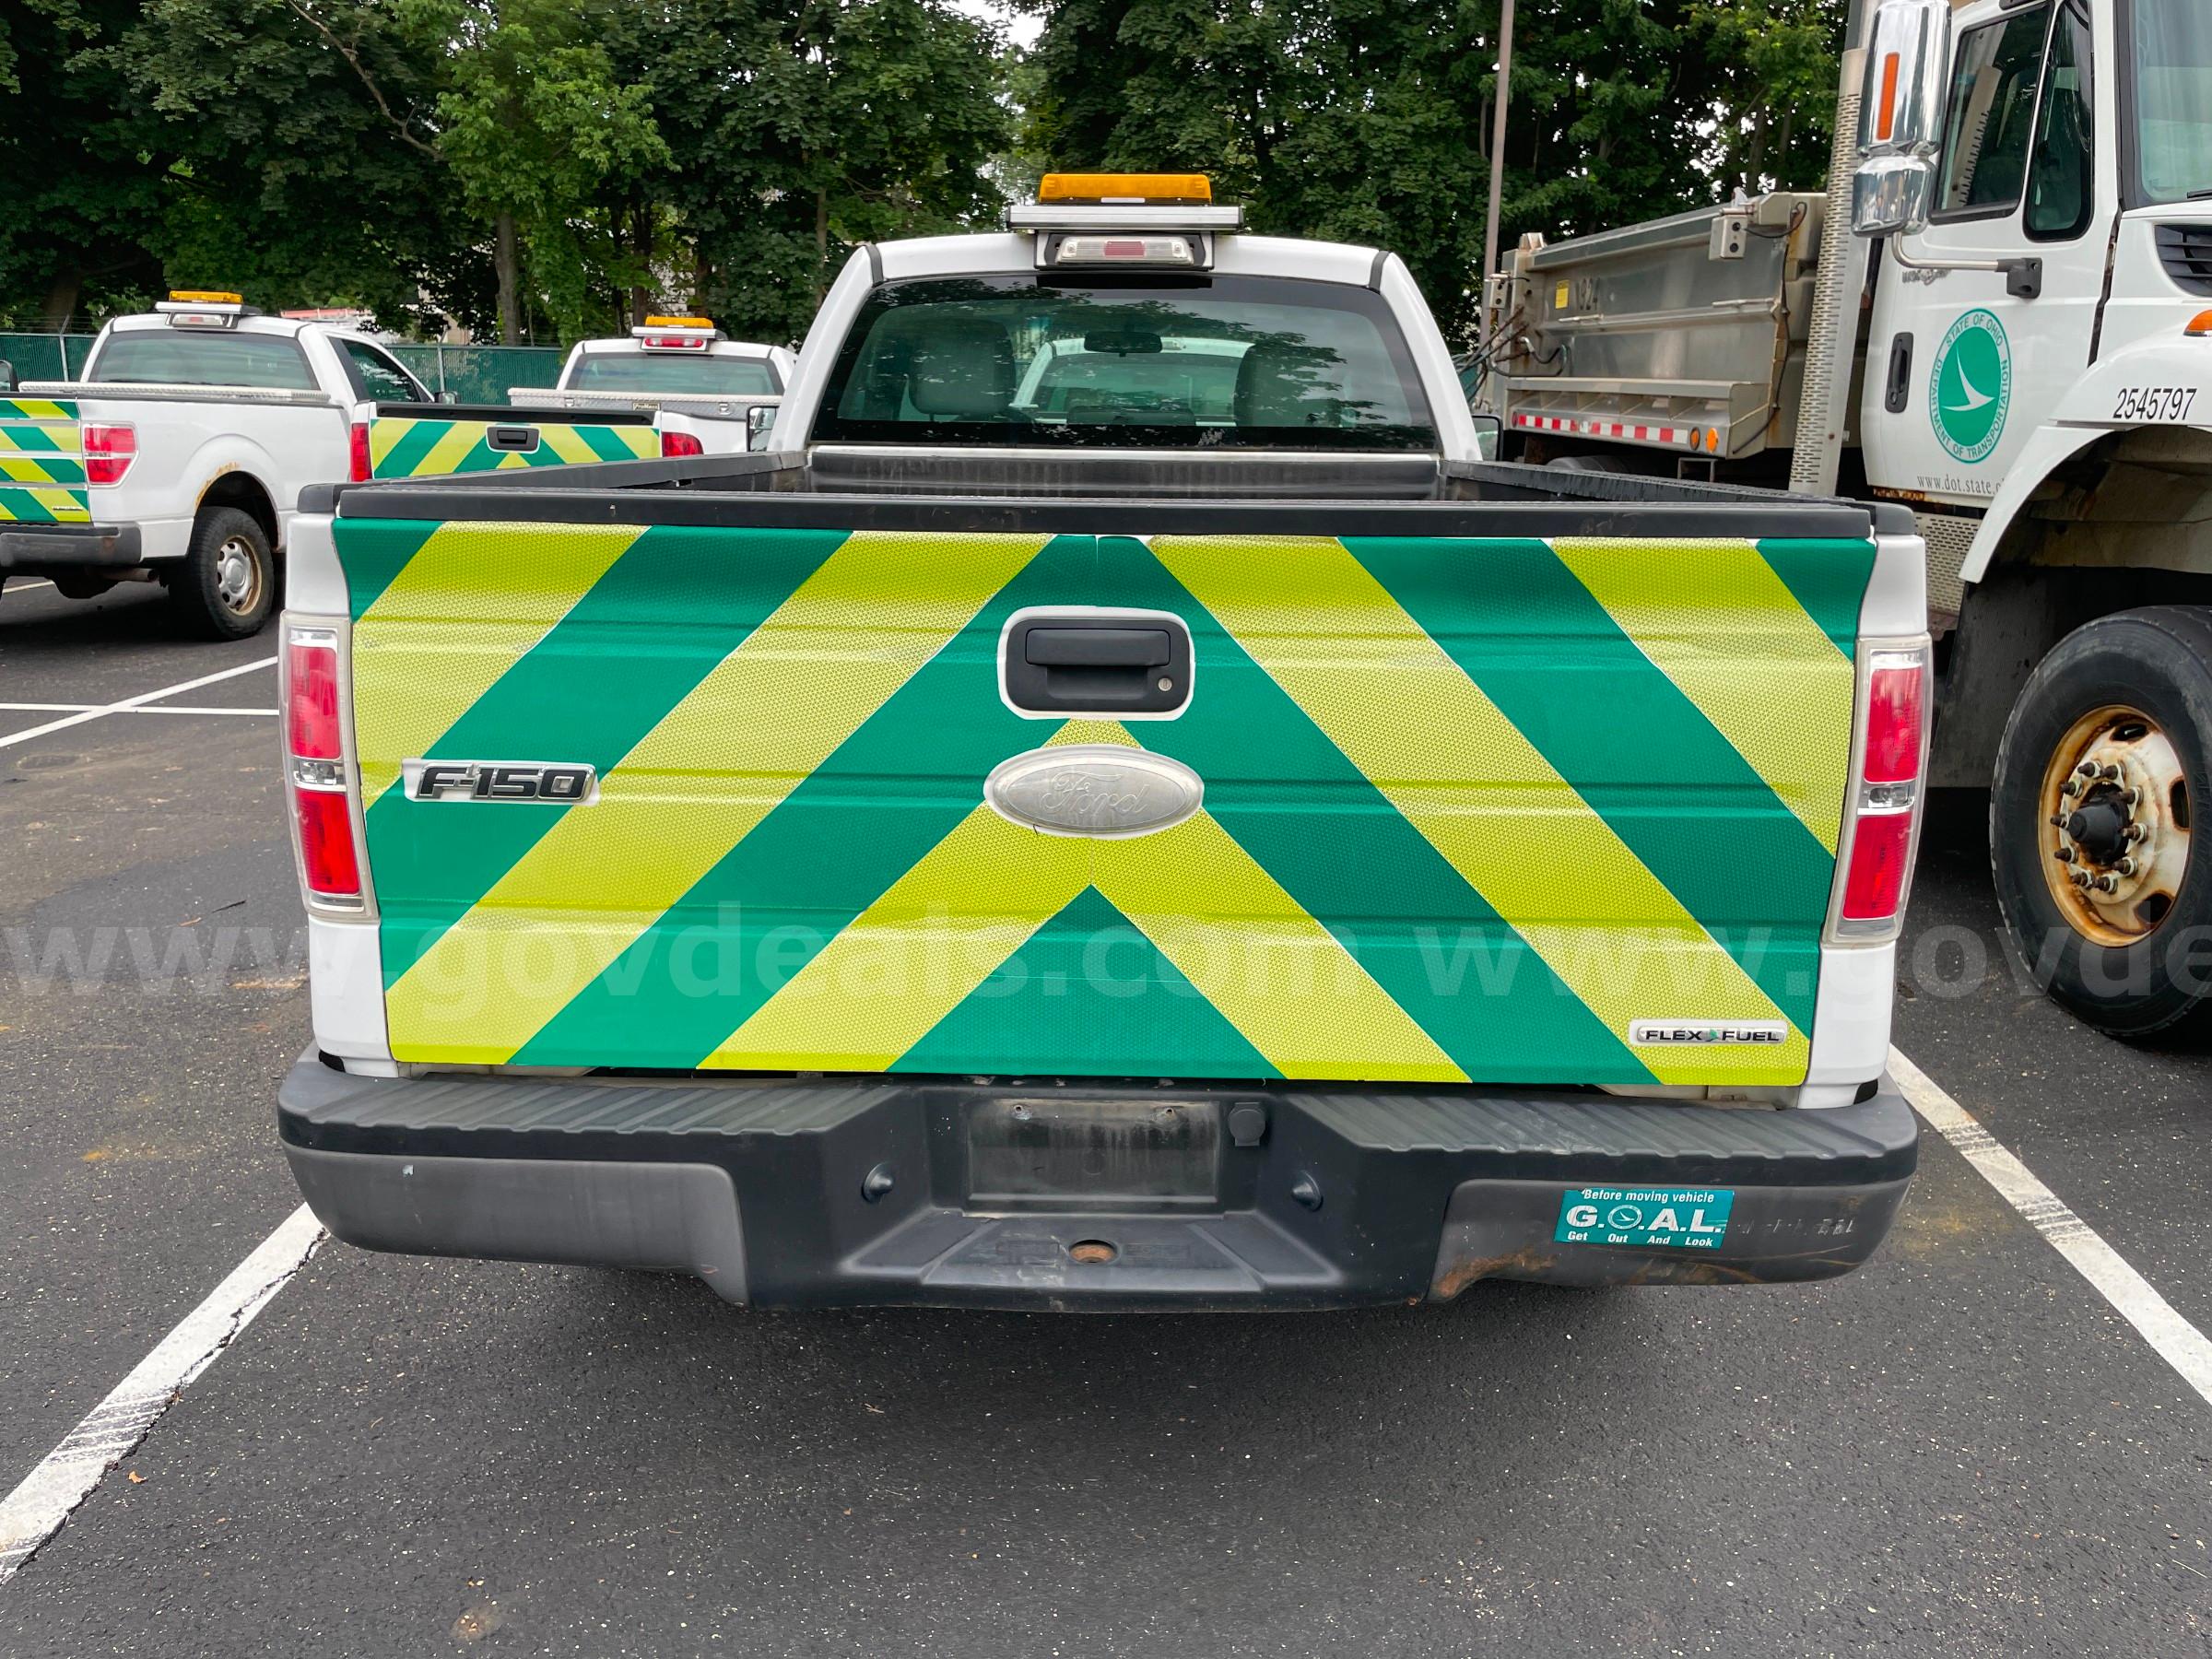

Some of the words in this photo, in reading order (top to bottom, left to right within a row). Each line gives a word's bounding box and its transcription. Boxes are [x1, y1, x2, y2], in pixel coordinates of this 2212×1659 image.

[1946, 317, 1970, 347] STATE
[1972, 314, 1985, 325] OF
[1986, 318, 2004, 347] OHIO
[1931, 359, 1952, 447] DEPARTMENT
[1953, 445, 1964, 456] OF
[1968, 359, 2008, 458] TRANSPORTATION
[2112, 387, 2197, 420] 2545797
[1917, 474, 2005, 495] www.dot.state.o
[416, 763, 596, 802] F-150
[1645, 1030, 1703, 1041] FLEX
[1722, 1030, 1780, 1041] FUEL
[1583, 1189, 1622, 1200] Before
[1625, 1191, 1668, 1204] moving
[1673, 1193, 1714, 1203] vehicle
[1568, 1230, 1589, 1241] Get
[1607, 1233, 1629, 1243] Out
[1647, 1235, 1671, 1245] And
[1685, 1236, 1713, 1247] Look
